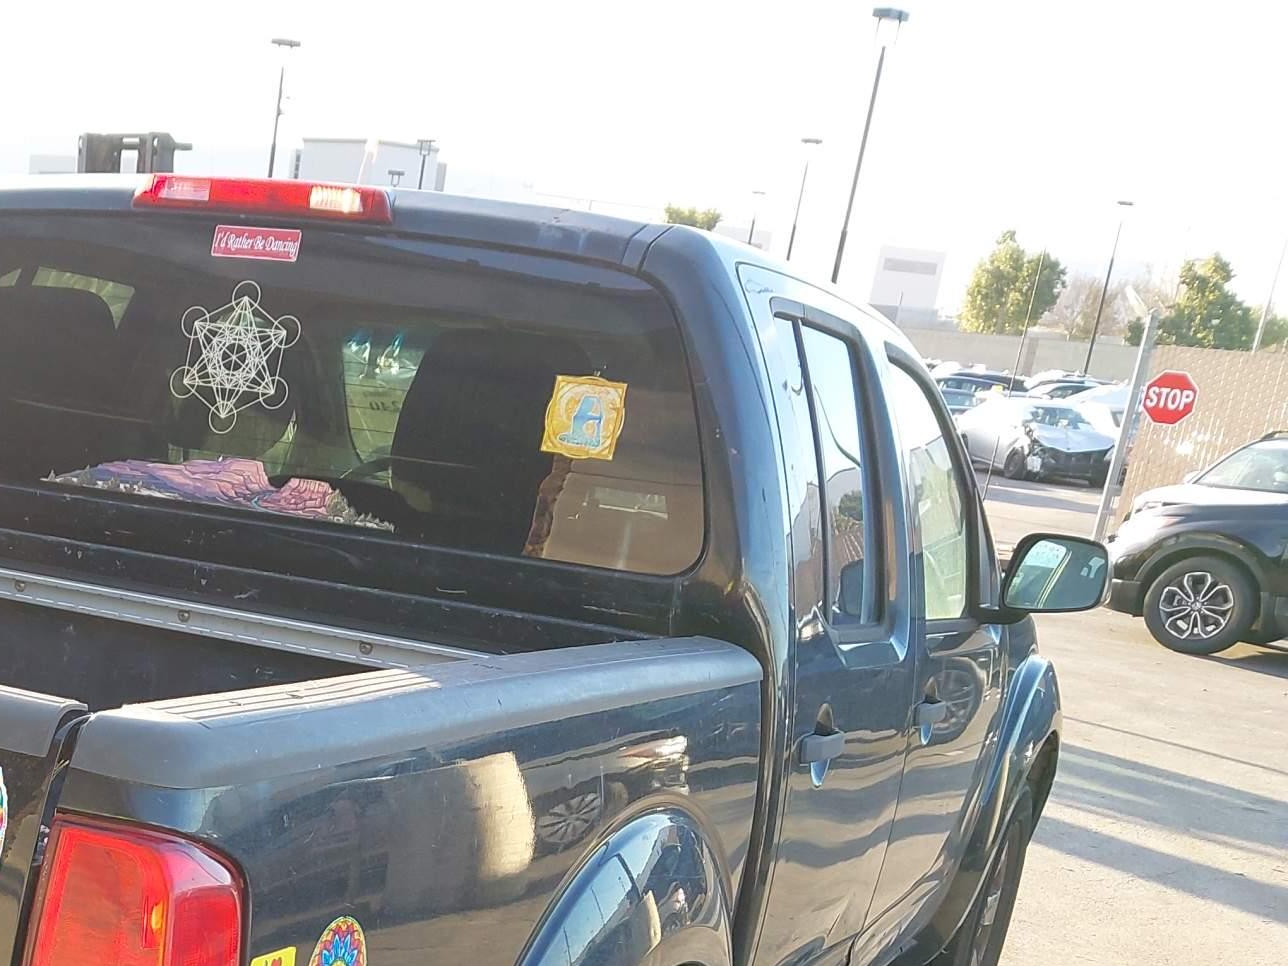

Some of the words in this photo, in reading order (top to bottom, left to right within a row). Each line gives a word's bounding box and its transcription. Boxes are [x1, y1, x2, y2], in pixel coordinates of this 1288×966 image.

[215, 231, 230, 248] I'd
[227, 232, 255, 251] Rather
[253, 235, 265, 250] Be
[265, 236, 297, 257] Dancing
[1145, 386, 1195, 411] STOP
